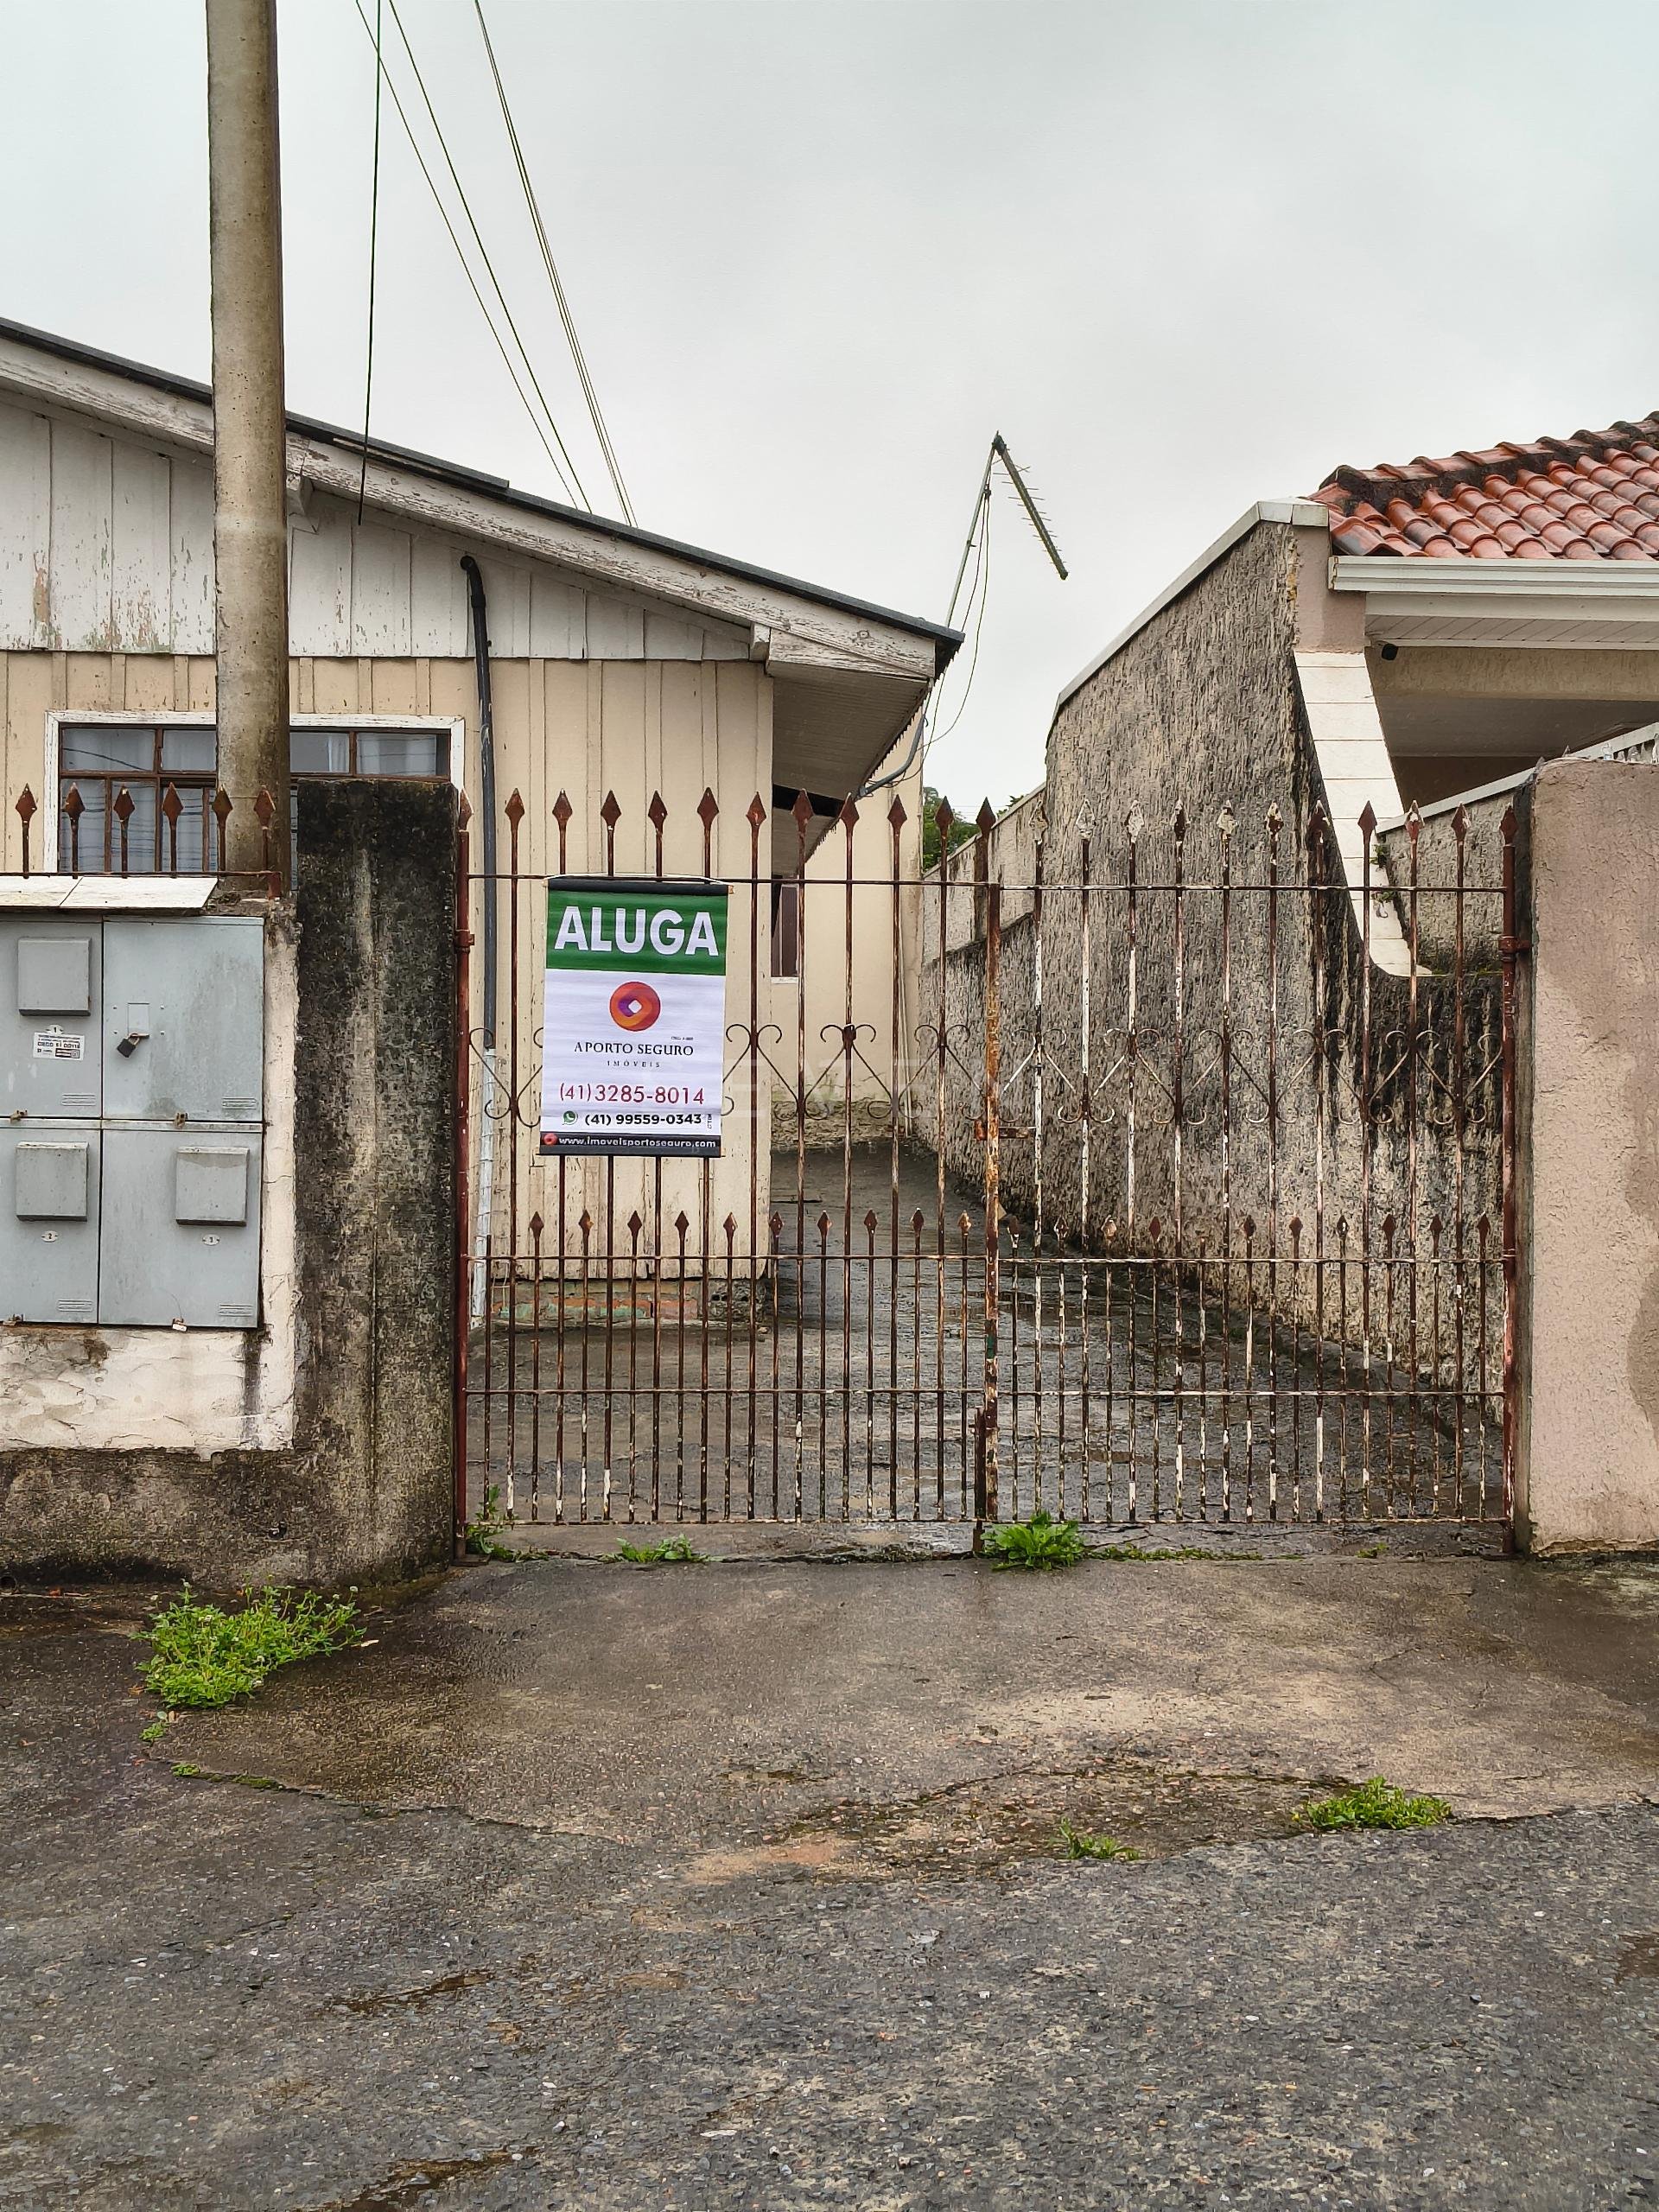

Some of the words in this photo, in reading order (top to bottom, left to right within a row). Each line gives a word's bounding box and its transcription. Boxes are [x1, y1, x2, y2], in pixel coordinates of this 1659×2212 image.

[554, 906, 721, 957] ALUGA
[637, 1044, 694, 1056] SEGURO
[560, 1083, 704, 1105] (41)3285-8014
[585, 1113, 612, 1126] (41)
[615, 1113, 702, 1125] 99559-0343
